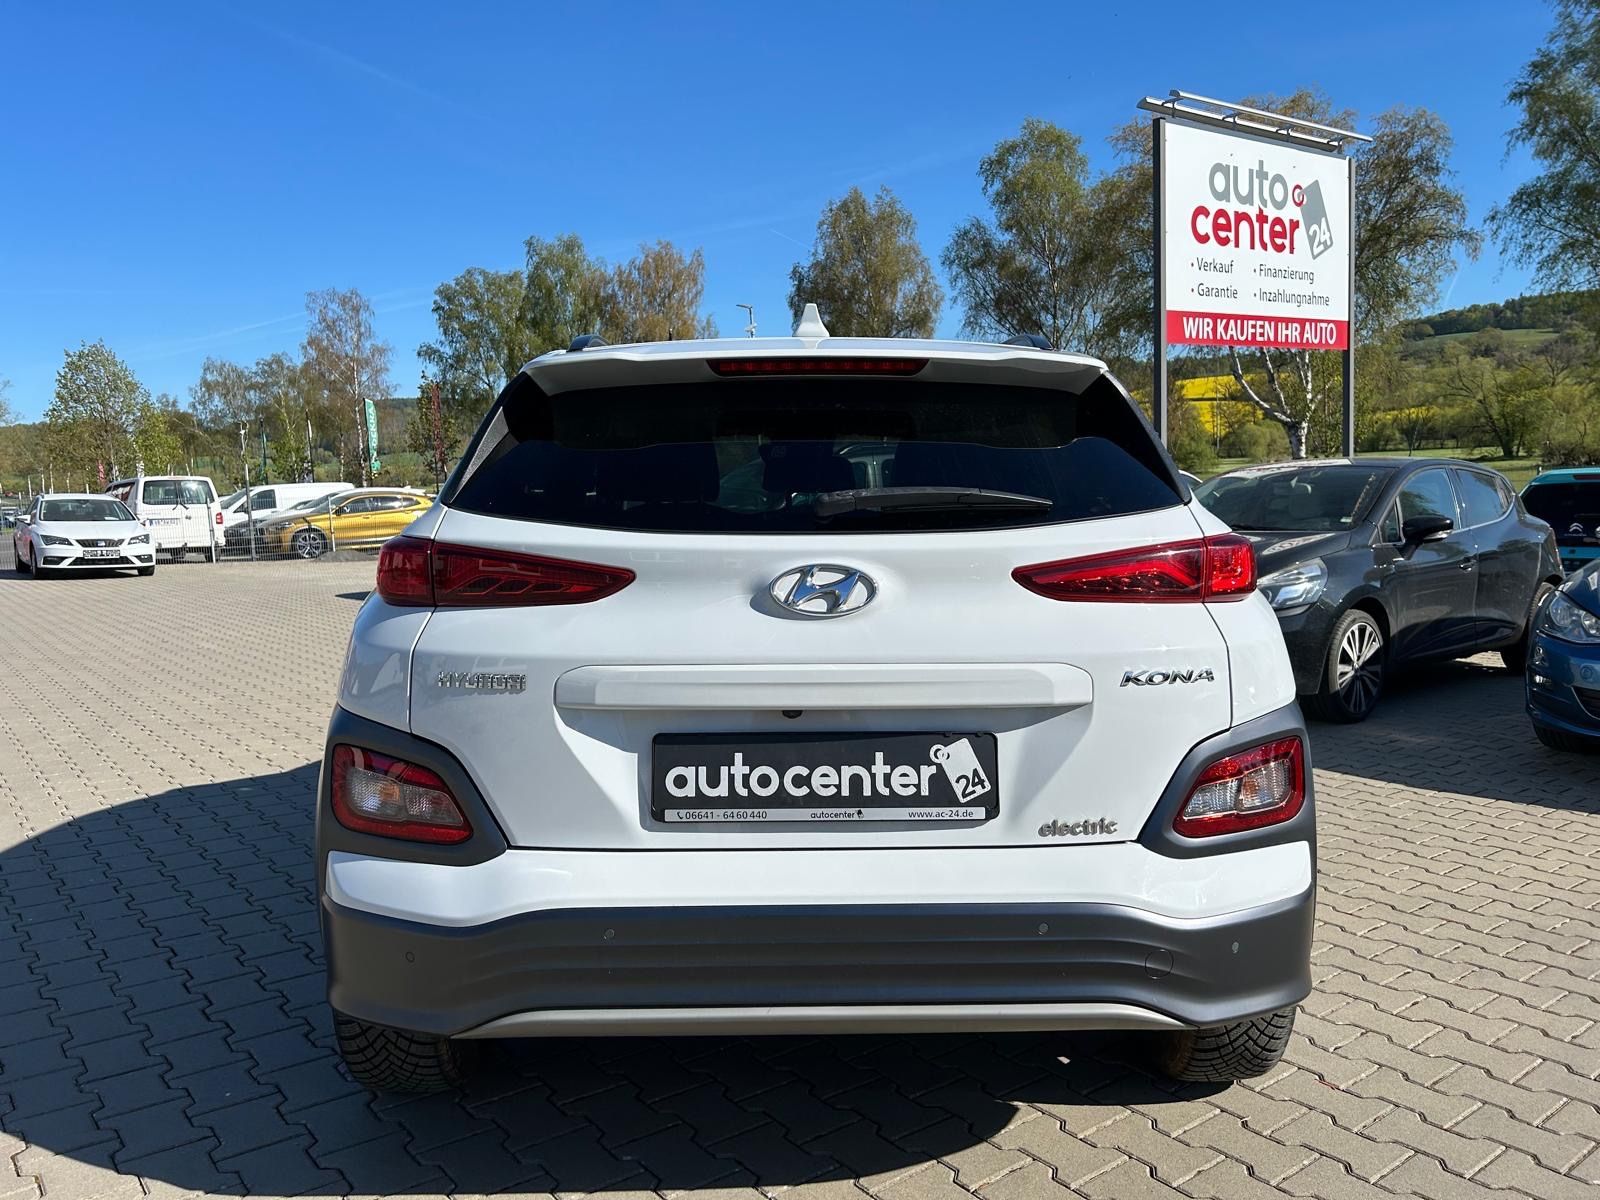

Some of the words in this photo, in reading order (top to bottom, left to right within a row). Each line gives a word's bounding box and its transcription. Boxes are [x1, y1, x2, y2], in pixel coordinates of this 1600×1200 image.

[1209, 160, 1288, 210] auto
[1191, 205, 1300, 254] center
[1309, 217, 1331, 252] 24
[1197, 257, 1234, 274] Verkauf
[1259, 263, 1315, 284] Finanzierung
[1197, 283, 1238, 299] Garantie
[1259, 288, 1330, 307] Inzahlungnahme
[1183, 316, 1213, 340] WIR
[1217, 318, 1274, 342] KAUFEN
[1278, 322, 1301, 343] IHR
[1303, 323, 1337, 345] AUTO
[1120, 668, 1215, 687] KONA
[954, 768, 986, 800] 24
[685, 811, 714, 820] 06641
[810, 810, 856, 819] autocenter
[908, 809, 974, 819] www.ac-24.de
[1038, 817, 1118, 837] electric
